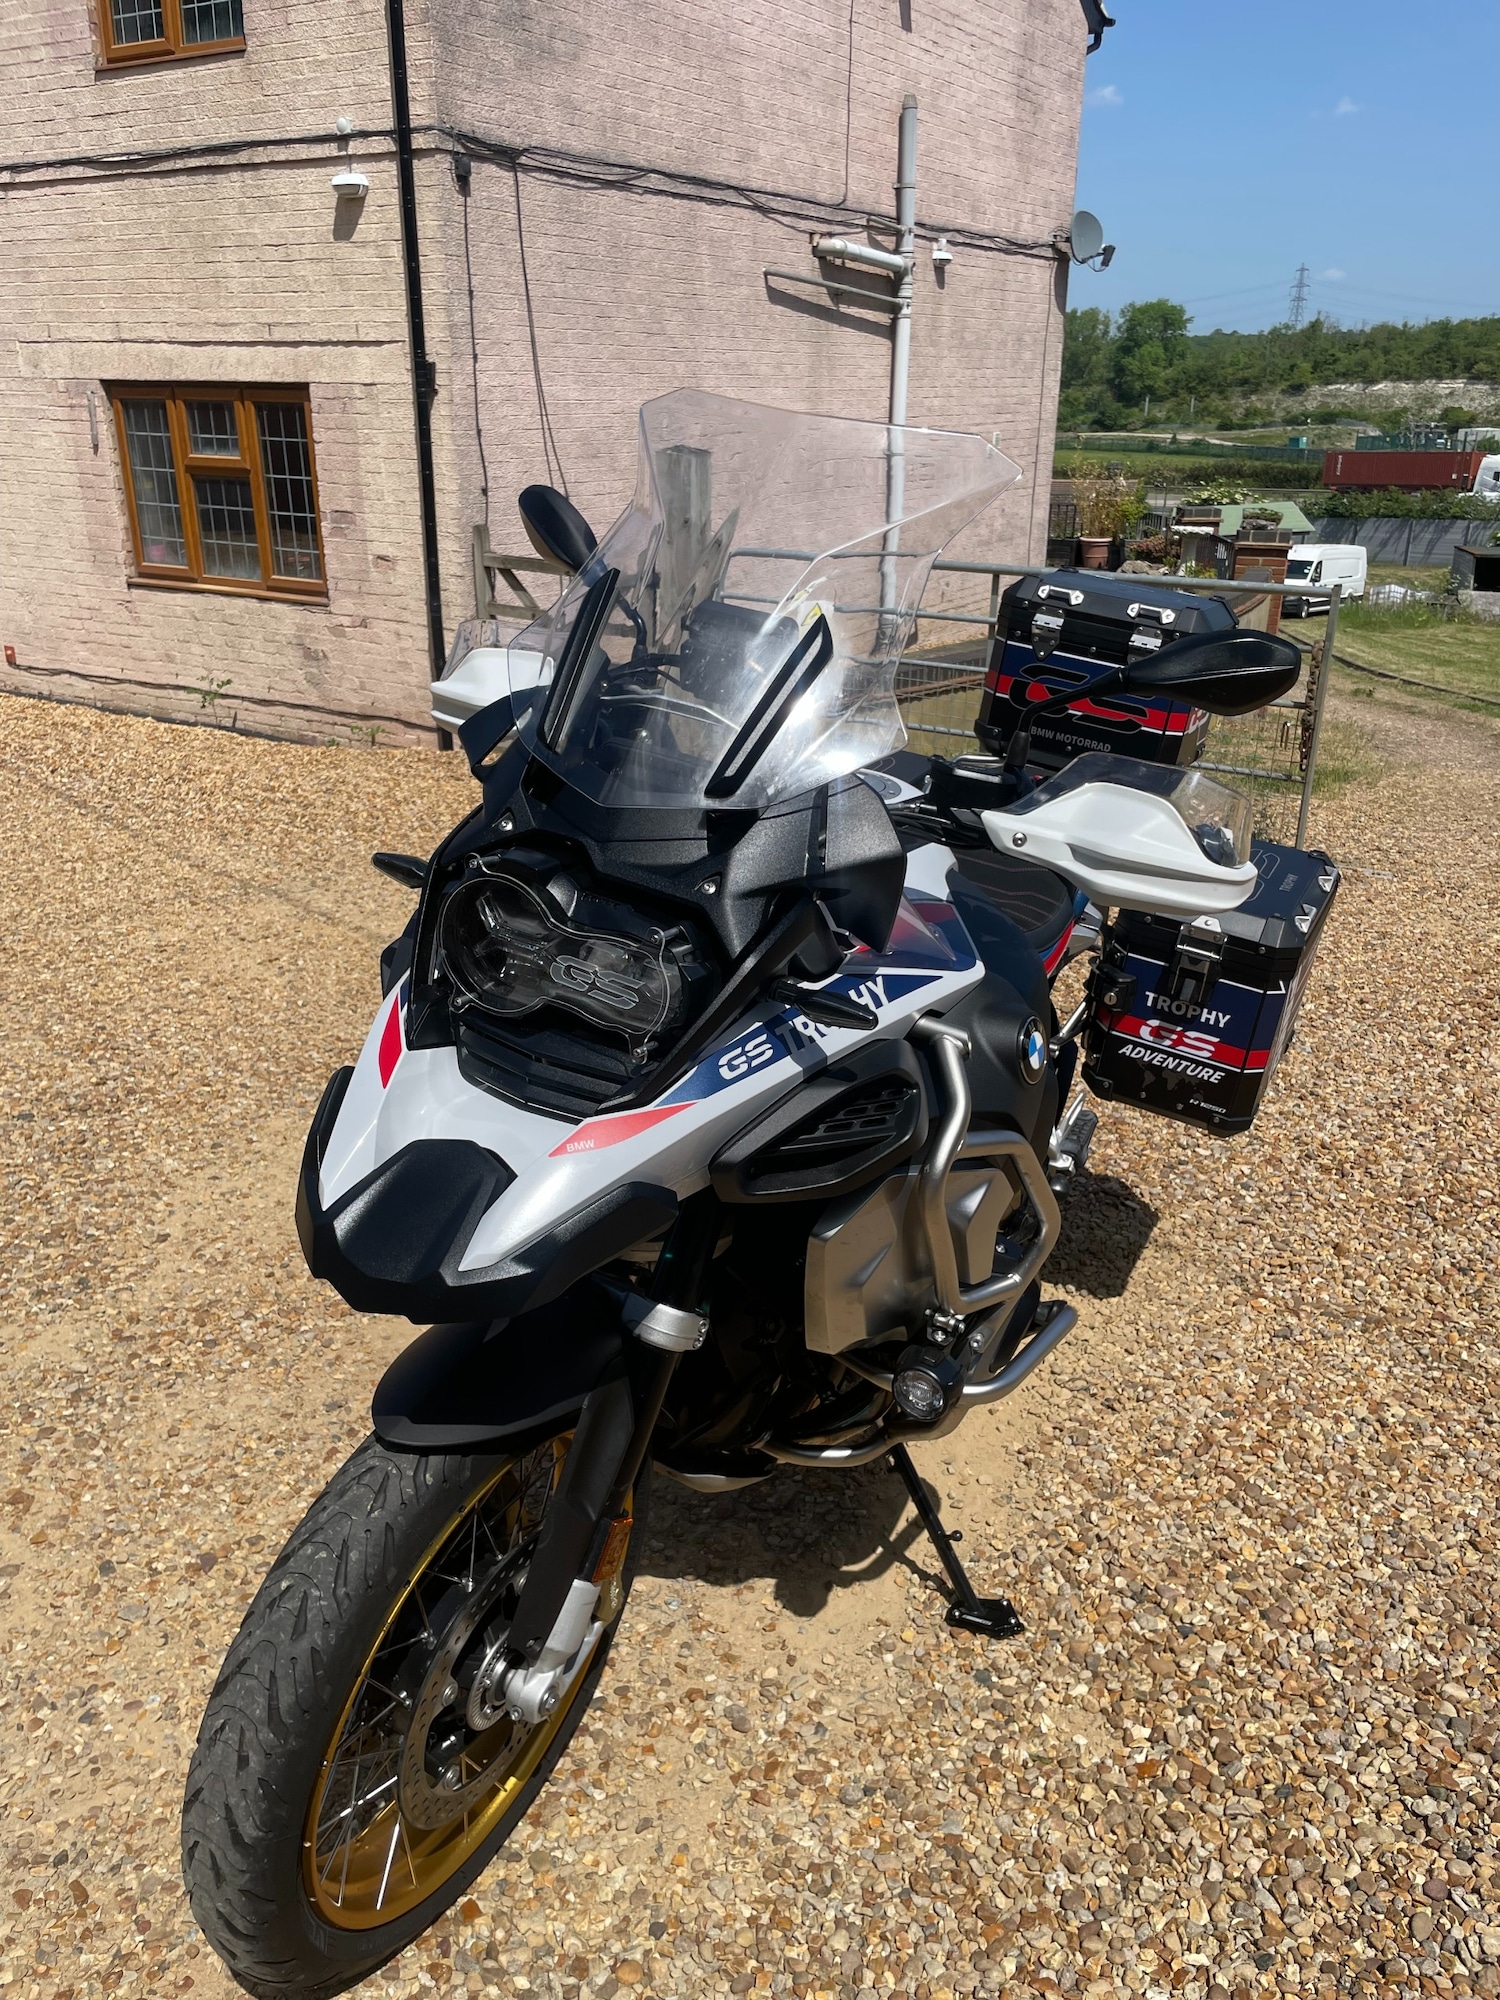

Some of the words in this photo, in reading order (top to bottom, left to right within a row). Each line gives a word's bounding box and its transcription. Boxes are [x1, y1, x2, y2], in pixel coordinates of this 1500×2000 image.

[1030, 726, 1057, 739] BMW
[1056, 732, 1112, 752] MOTORRAD
[550, 955, 646, 1010] GS
[718, 1033, 774, 1080] GS
[775, 976, 889, 1053] TRHY
[1145, 991, 1231, 1028] TROPHY
[1140, 1019, 1220, 1058] GS
[1118, 1044, 1226, 1084] ADVENTURE
[566, 1139, 595, 1153] BMW
